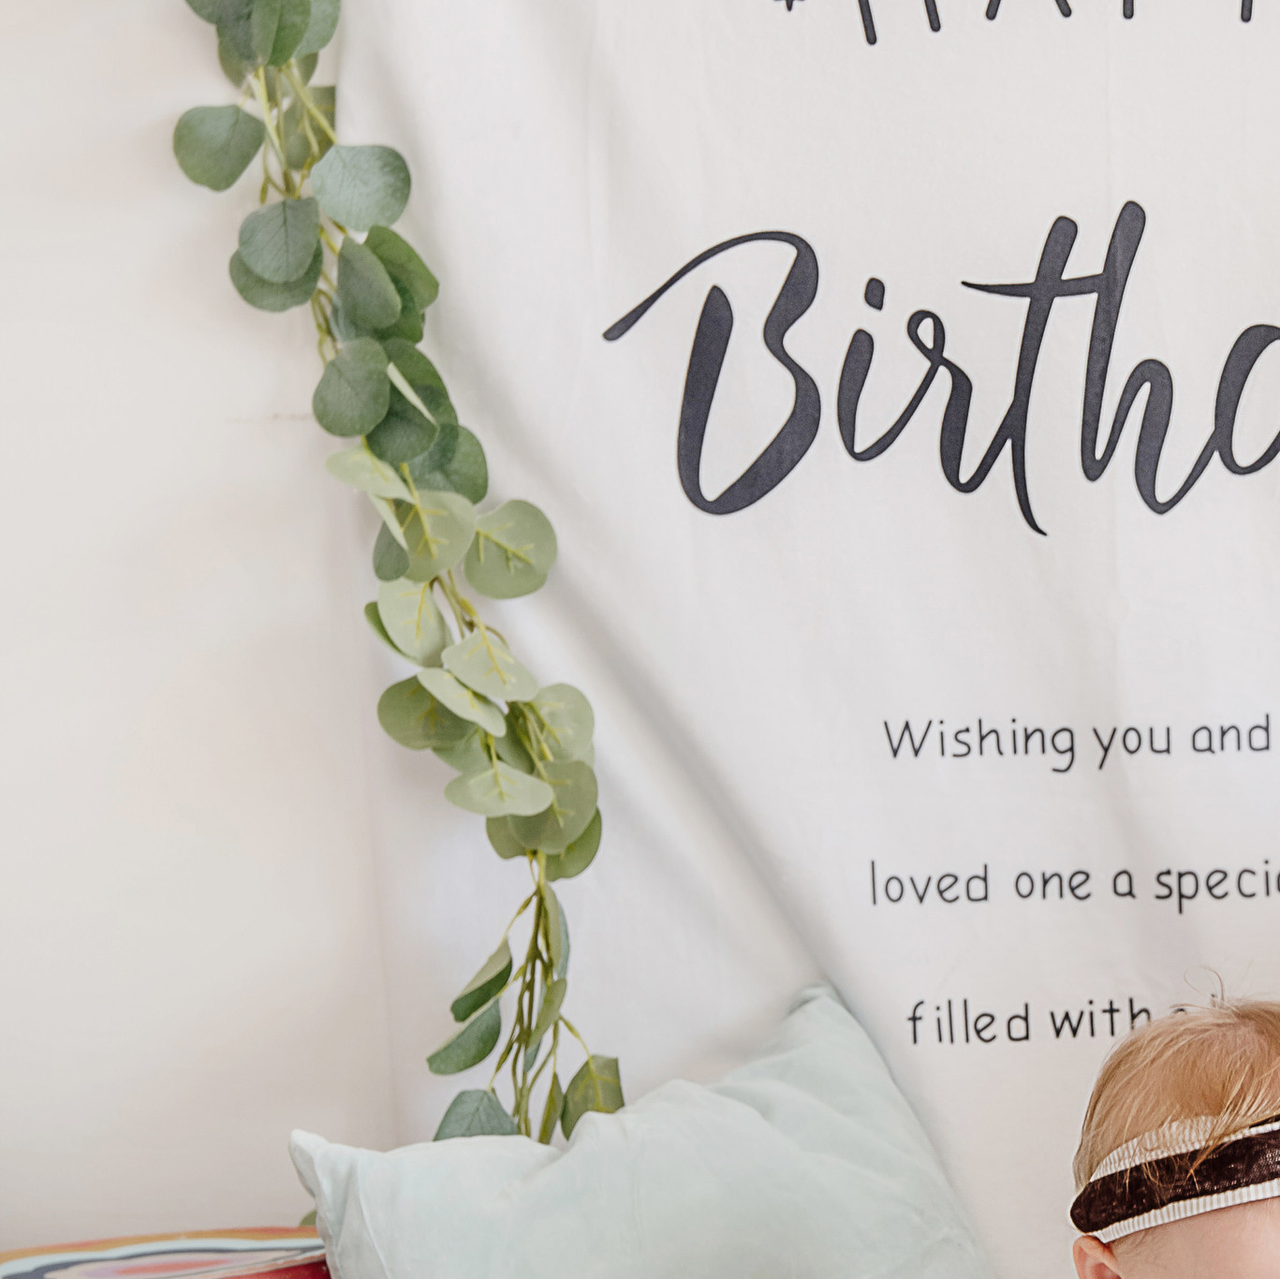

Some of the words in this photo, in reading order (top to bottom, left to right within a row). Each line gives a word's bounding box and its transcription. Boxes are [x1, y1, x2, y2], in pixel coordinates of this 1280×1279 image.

[884, 718, 1076, 773] Wishing
[1092, 725, 1172, 770] you
[1191, 713, 1271, 755] and
[870, 860, 989, 906] loved
[1014, 869, 1092, 901] one
[1112, 869, 1137, 900] a
[906, 997, 1031, 1045] filled
